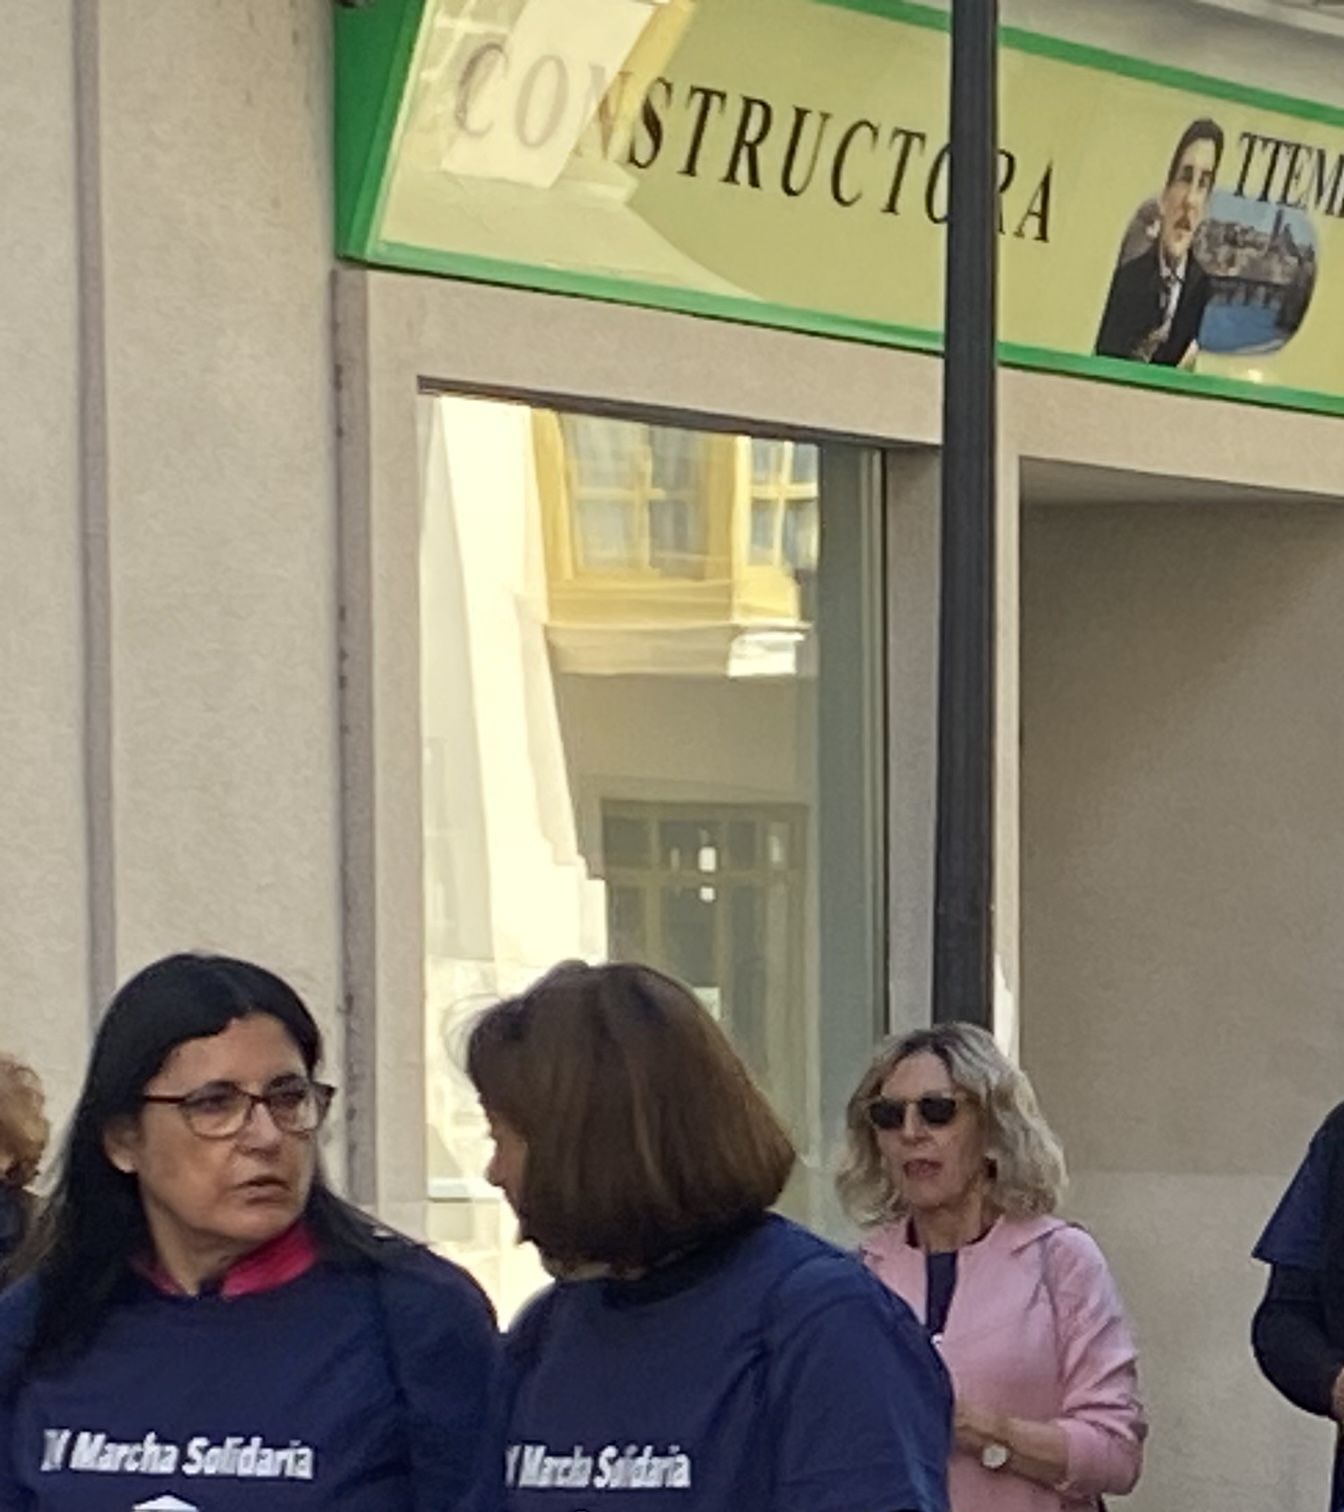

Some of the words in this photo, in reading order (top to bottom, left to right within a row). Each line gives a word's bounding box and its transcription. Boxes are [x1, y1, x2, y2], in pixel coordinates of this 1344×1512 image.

[69, 1431, 179, 1475] Marcha
[182, 1436, 313, 1480] Solidaria
[519, 1445, 593, 1488] Marcha
[594, 1445, 691, 1488] Solidaria
